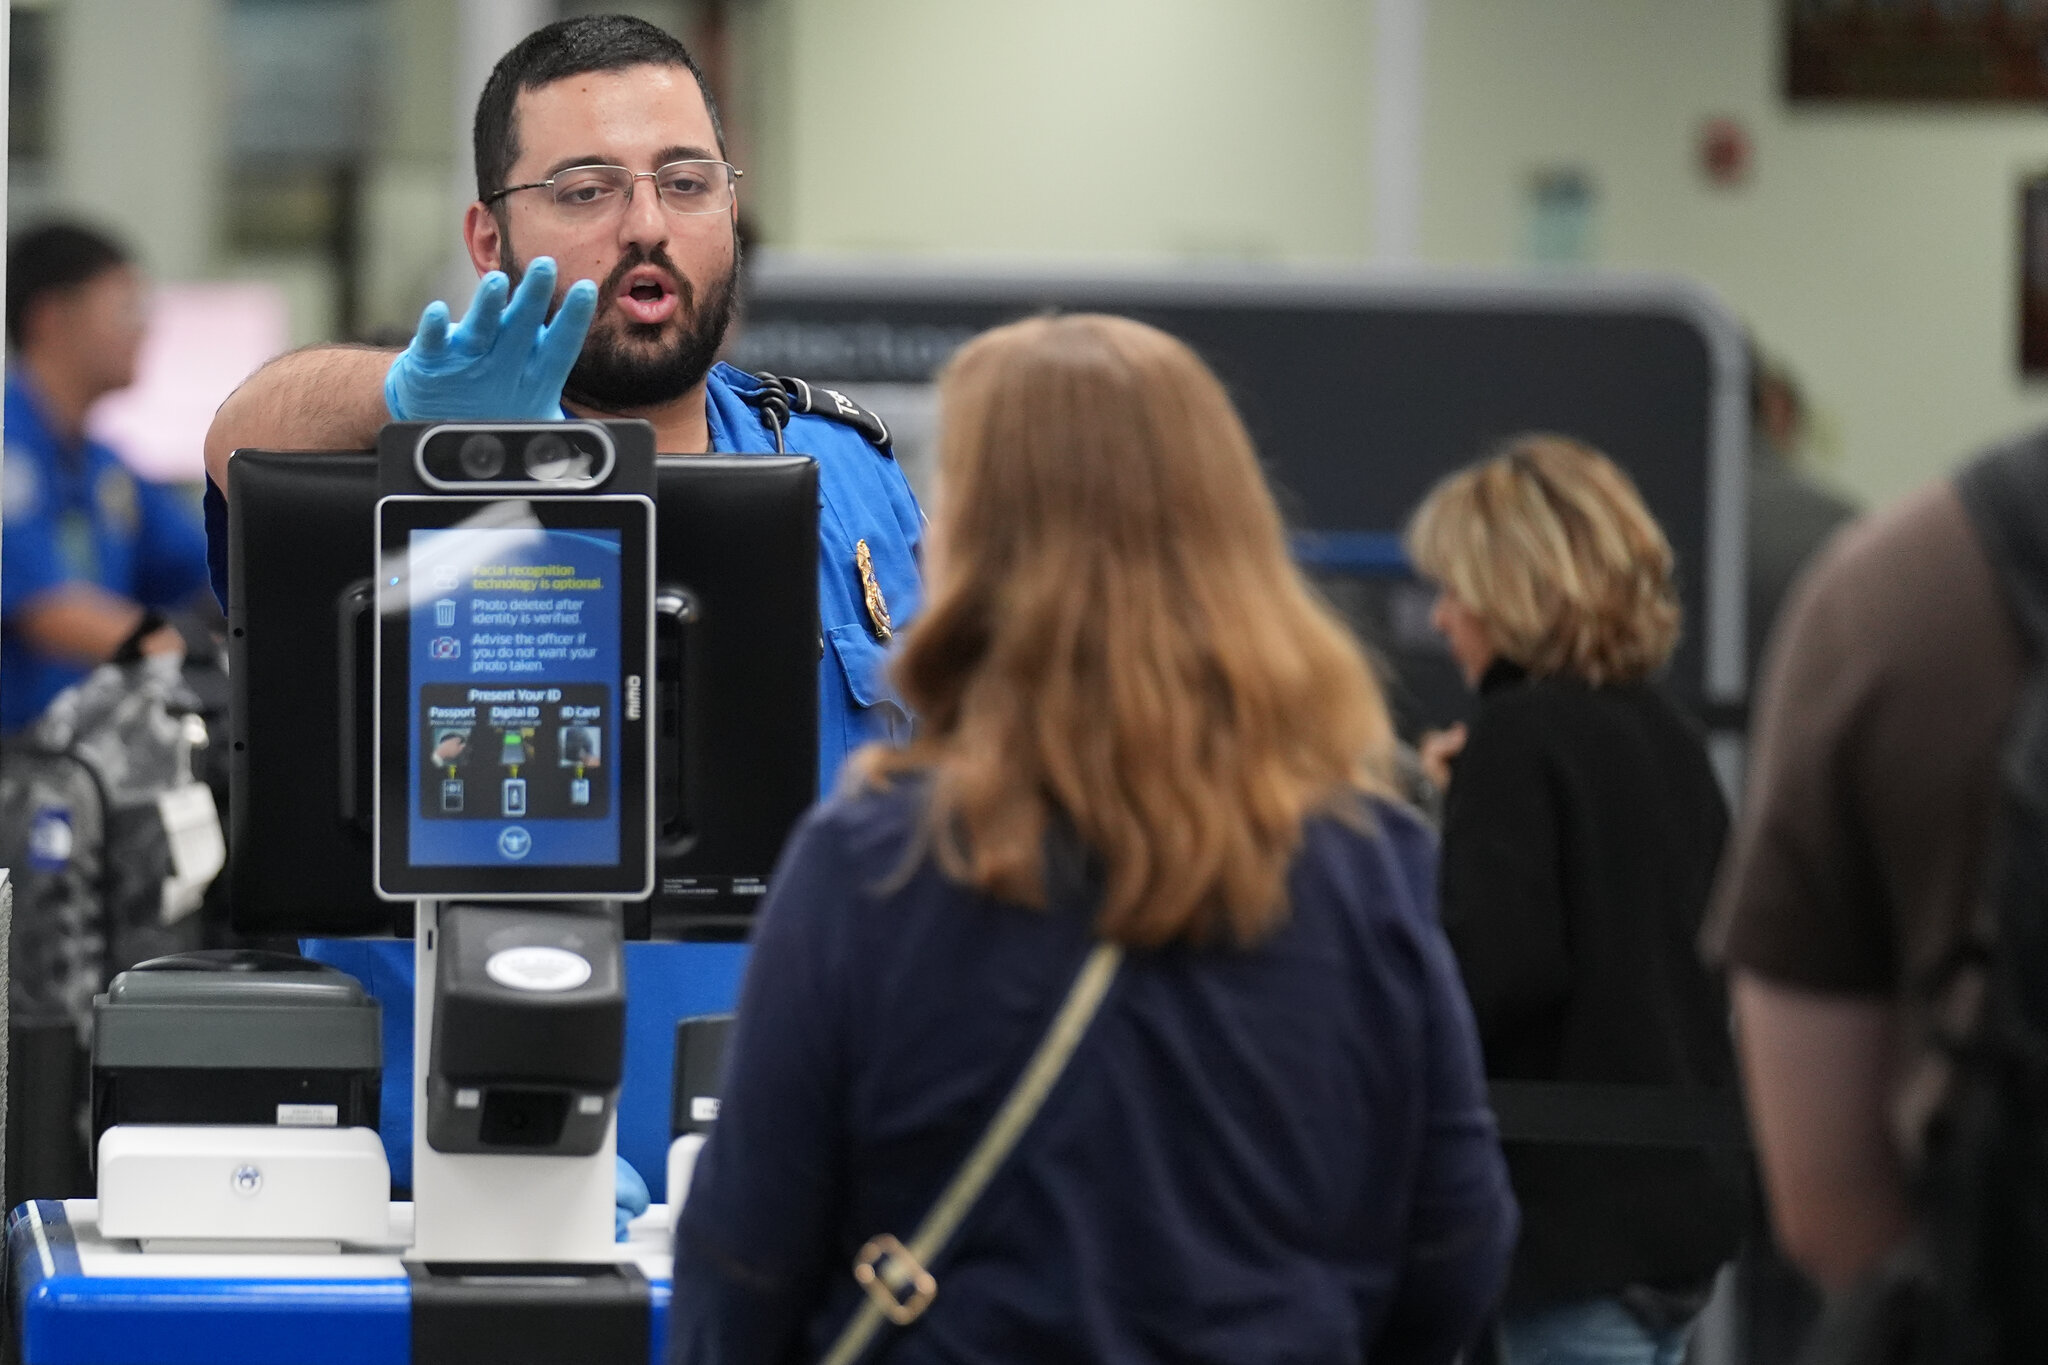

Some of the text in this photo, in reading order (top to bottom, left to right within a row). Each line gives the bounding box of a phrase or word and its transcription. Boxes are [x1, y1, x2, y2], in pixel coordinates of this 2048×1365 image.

[473, 564, 576, 578] Facial recognition
[473, 578, 605, 592] technology is optional.
[472, 598, 585, 610] Photo deleted after
[472, 612, 582, 627] identity is verified.
[472, 632, 587, 645] Advise the officer if
[472, 646, 599, 660] you do not want your
[472, 659, 545, 674] photo taken.
[468, 688, 562, 702] Present Your ID
[626, 675, 641, 720] mimo
[429, 706, 476, 720] Passport
[491, 706, 540, 719] Digital ID
[560, 706, 601, 718] ID Card
